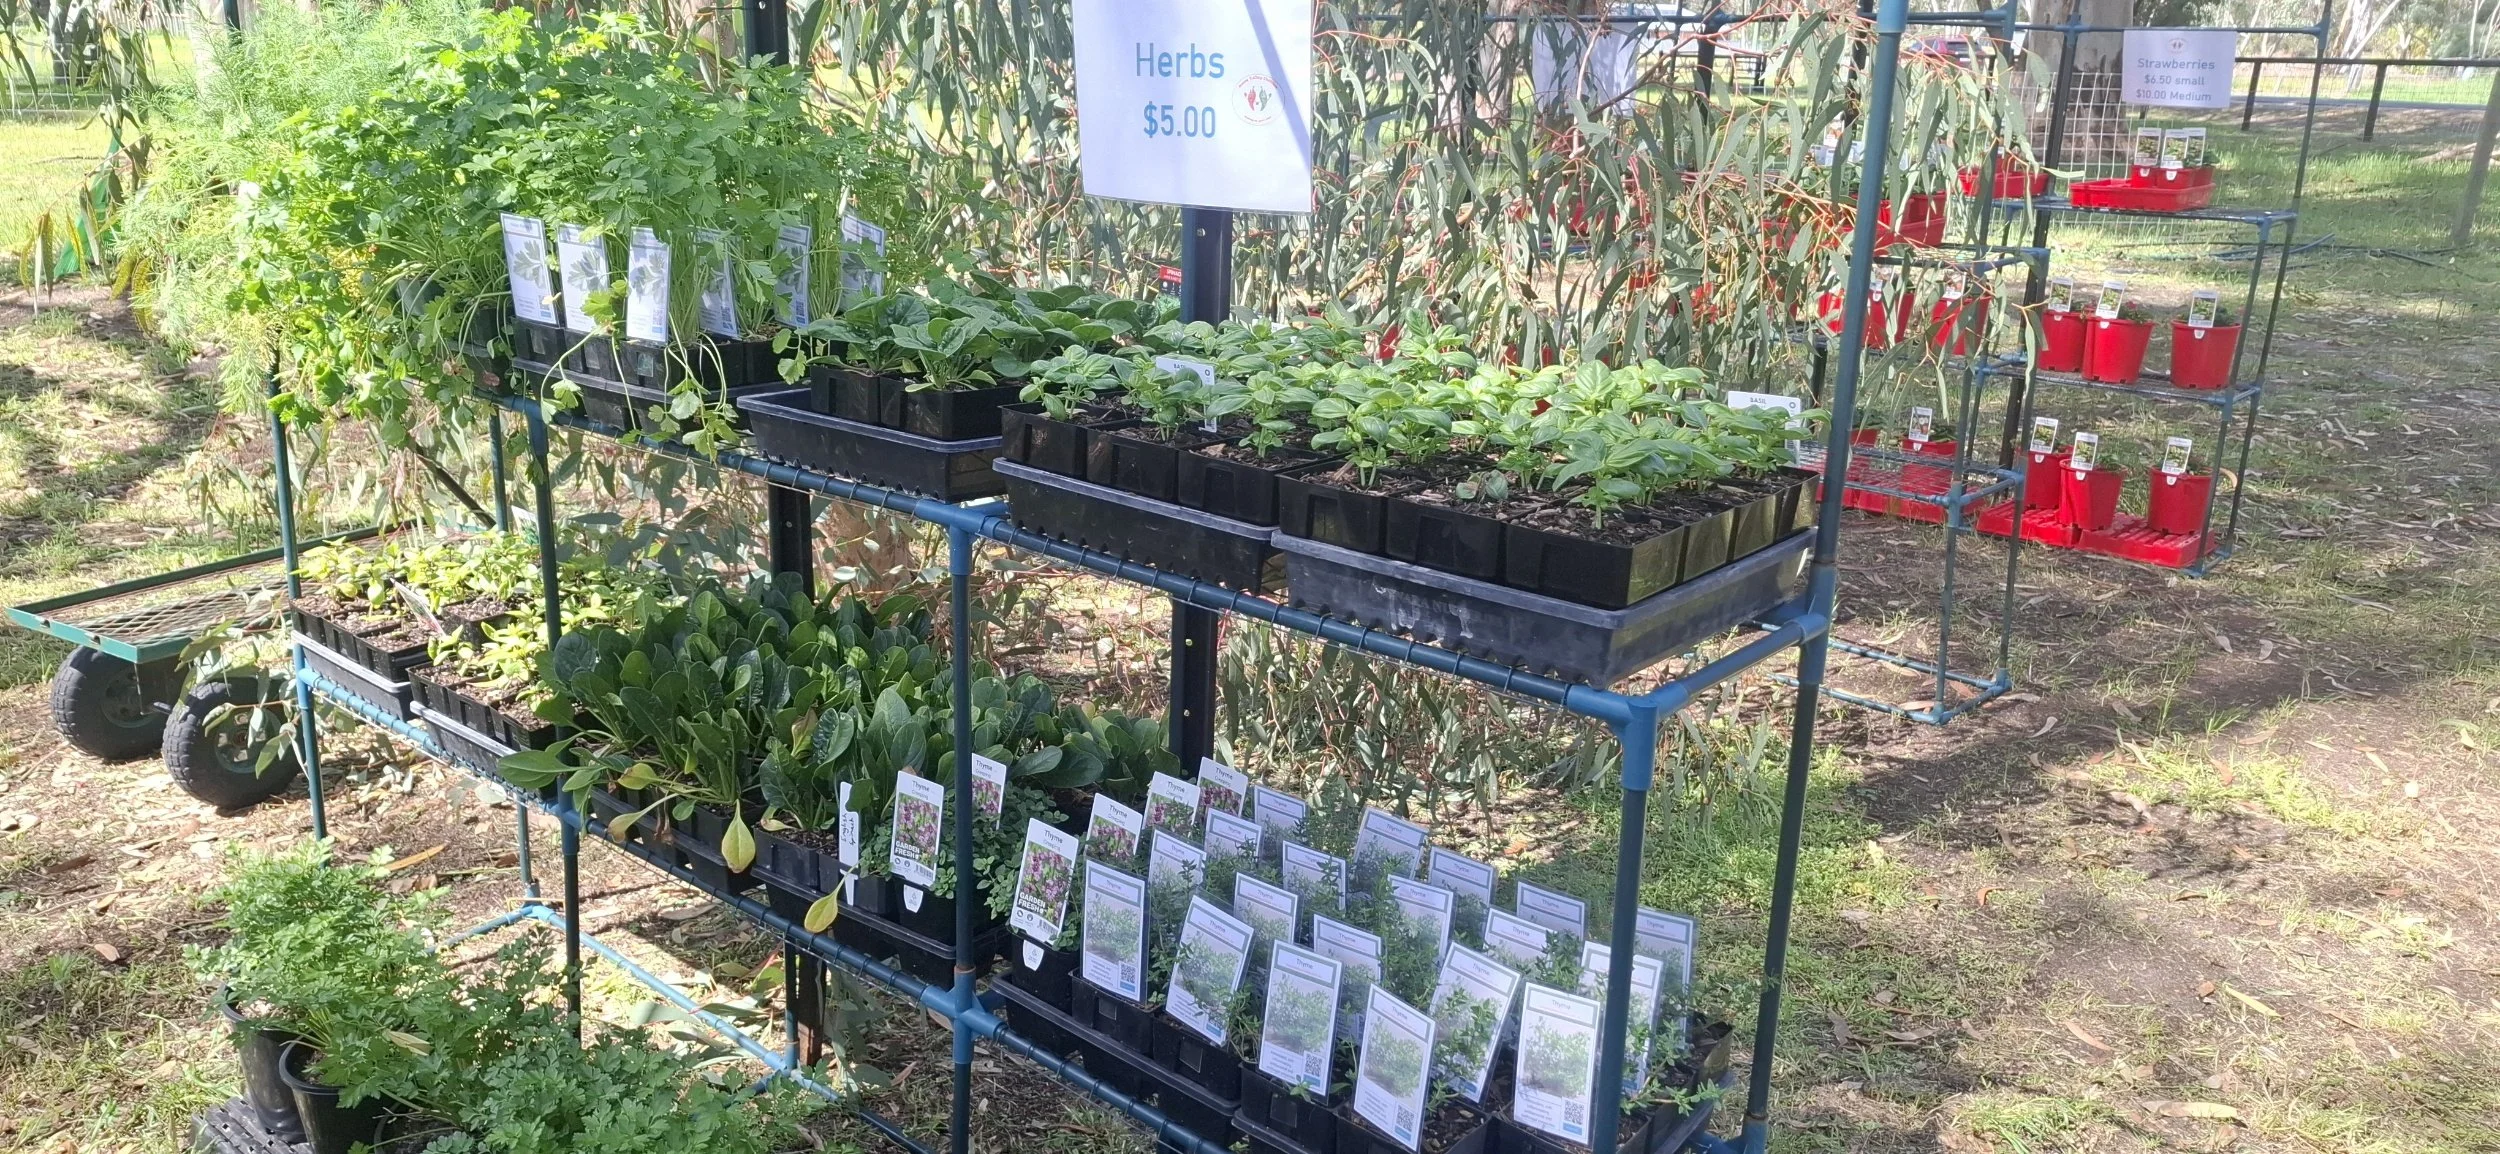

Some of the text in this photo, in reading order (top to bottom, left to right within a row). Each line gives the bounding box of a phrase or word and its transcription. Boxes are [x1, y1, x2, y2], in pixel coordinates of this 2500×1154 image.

[1135, 42, 1225, 79] Herbs
[2137, 58, 2215, 70] Strawberries
[2144, 74, 2205, 86] $6.50 small
[2136, 89, 2211, 101] $10.00 Medium
[1143, 101, 1216, 138] $5.00
[976, 760, 993, 771] Thyme
[1216, 766, 1233, 780] Thyme
[912, 780, 930, 792] Thyme
[1168, 780, 1185, 793] Thyme
[1109, 804, 1128, 818] Thyme
[1044, 830, 1063, 844] Thyme
[896, 841, 920, 853] GARDEN
[895, 848, 915, 859] FRESH
[1410, 888, 1426, 898] Thyme
[1020, 892, 1046, 908] GARDEN
[1542, 899, 1559, 909] Thyme
[1018, 900, 1040, 913] FRESH
[1210, 919, 1226, 933] Thyme
[1646, 920, 1665, 930] Thyme
[1512, 926, 1530, 937] Thyme
[1297, 958, 1314, 970] Thyme
[1473, 963, 1490, 975] Thyme
[1552, 999, 1571, 1010] Thyme
[1392, 1005, 1408, 1020] Thyme
